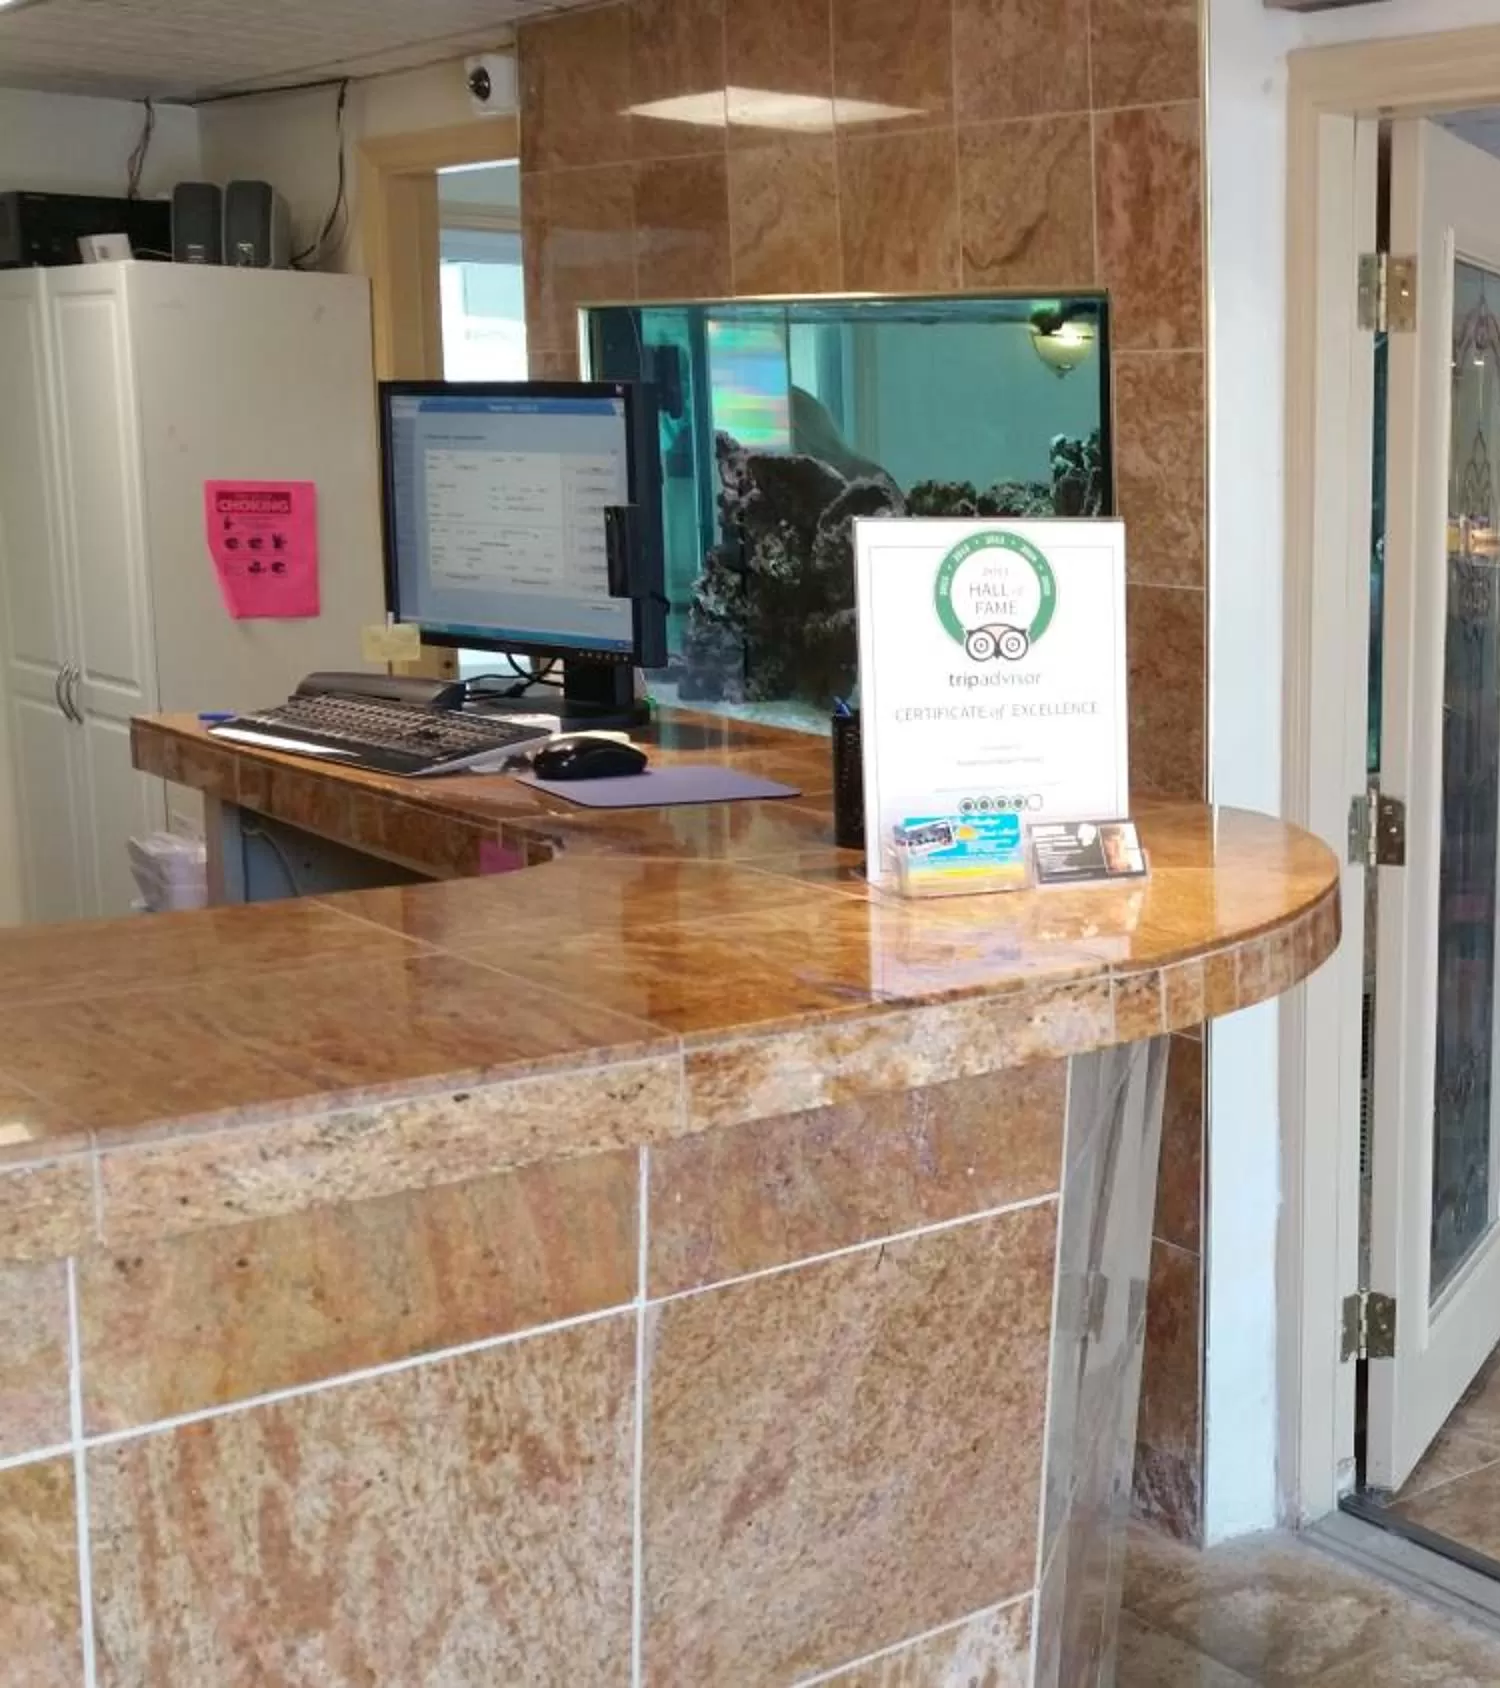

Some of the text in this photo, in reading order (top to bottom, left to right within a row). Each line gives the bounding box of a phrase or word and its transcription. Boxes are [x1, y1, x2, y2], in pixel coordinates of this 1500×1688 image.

[218, 499, 289, 513] CHOKING
[969, 582, 1008, 597] HALL
[975, 601, 1018, 615] FAME
[948, 671, 1041, 691] tripadvisor
[895, 706, 989, 722] CERTIFICATE
[1012, 701, 1098, 718] EXCELLENCE
